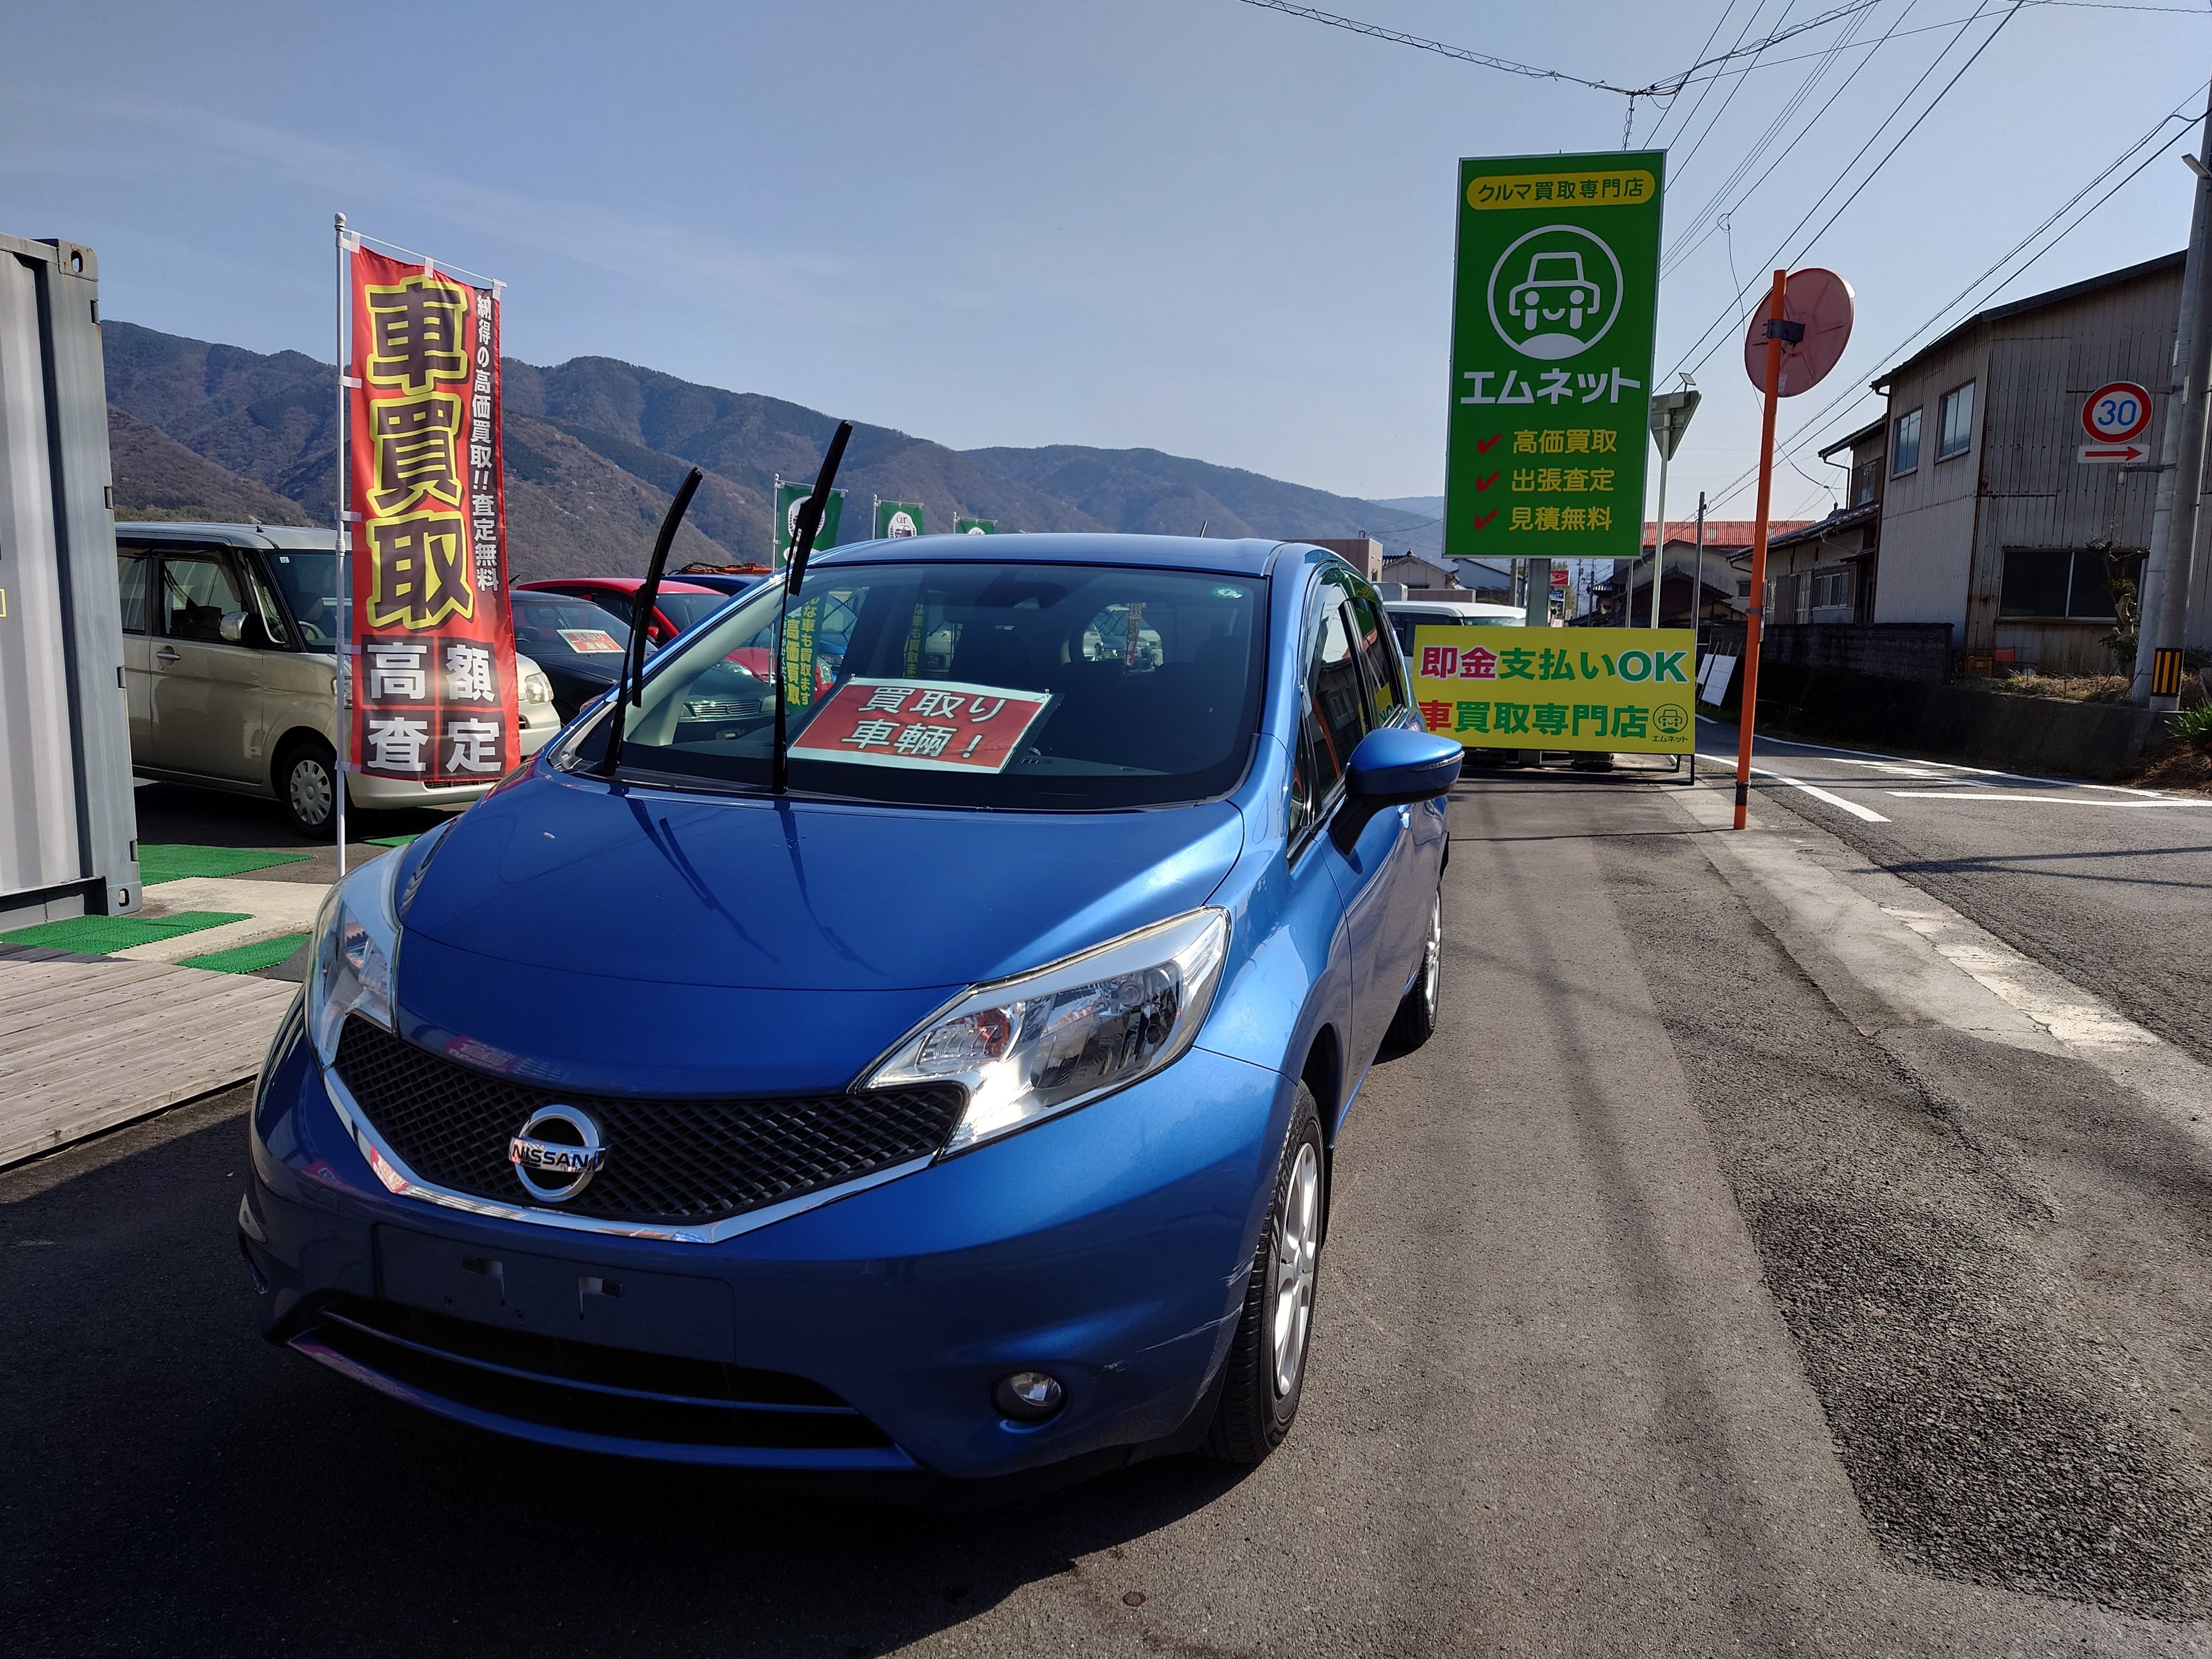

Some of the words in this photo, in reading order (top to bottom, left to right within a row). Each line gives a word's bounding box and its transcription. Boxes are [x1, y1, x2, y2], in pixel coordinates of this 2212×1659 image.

[1478, 177, 1643, 202] クルマ買取専門店
[1460, 367, 1641, 405] エムネット
[2097, 400, 2137, 426] 30
[365, 274, 474, 629] 車買取
[470, 294, 499, 592] 納得の高価買取!!査定無料
[1513, 429, 1617, 455] 高価買取
[1511, 468, 1615, 493] 出張査定
[1508, 506, 1613, 532] 見積無料
[907, 604, 925, 677] な車も買取ま
[368, 642, 495, 702] 高額
[1420, 645, 1690, 683] 即金支払いOK
[858, 687, 1007, 722] 買取り
[1419, 699, 1649, 739] 車買取専門店
[368, 717, 502, 772] 査定
[512, 1143, 589, 1168] NISSAN
